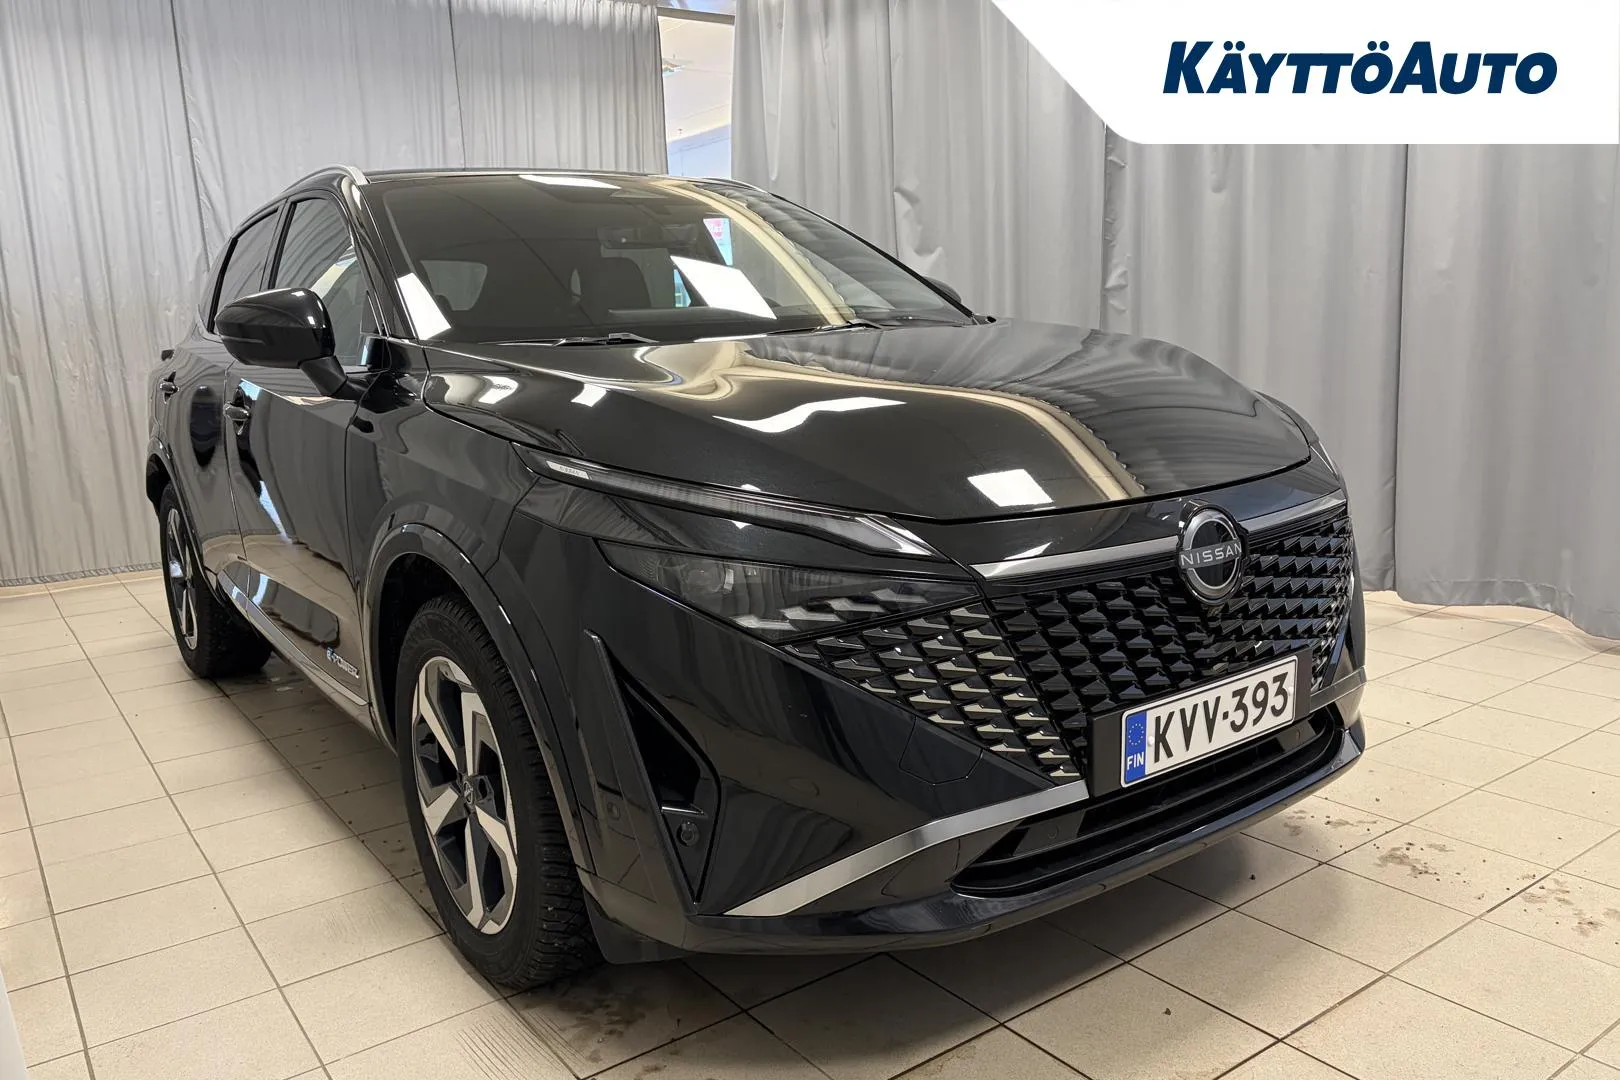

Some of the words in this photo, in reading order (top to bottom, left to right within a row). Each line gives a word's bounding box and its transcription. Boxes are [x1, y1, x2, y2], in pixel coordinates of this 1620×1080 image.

[1181, 543, 1242, 566] NISSAN
[1154, 672, 1289, 763] KVV-393
[1127, 752, 1144, 772] FIN
